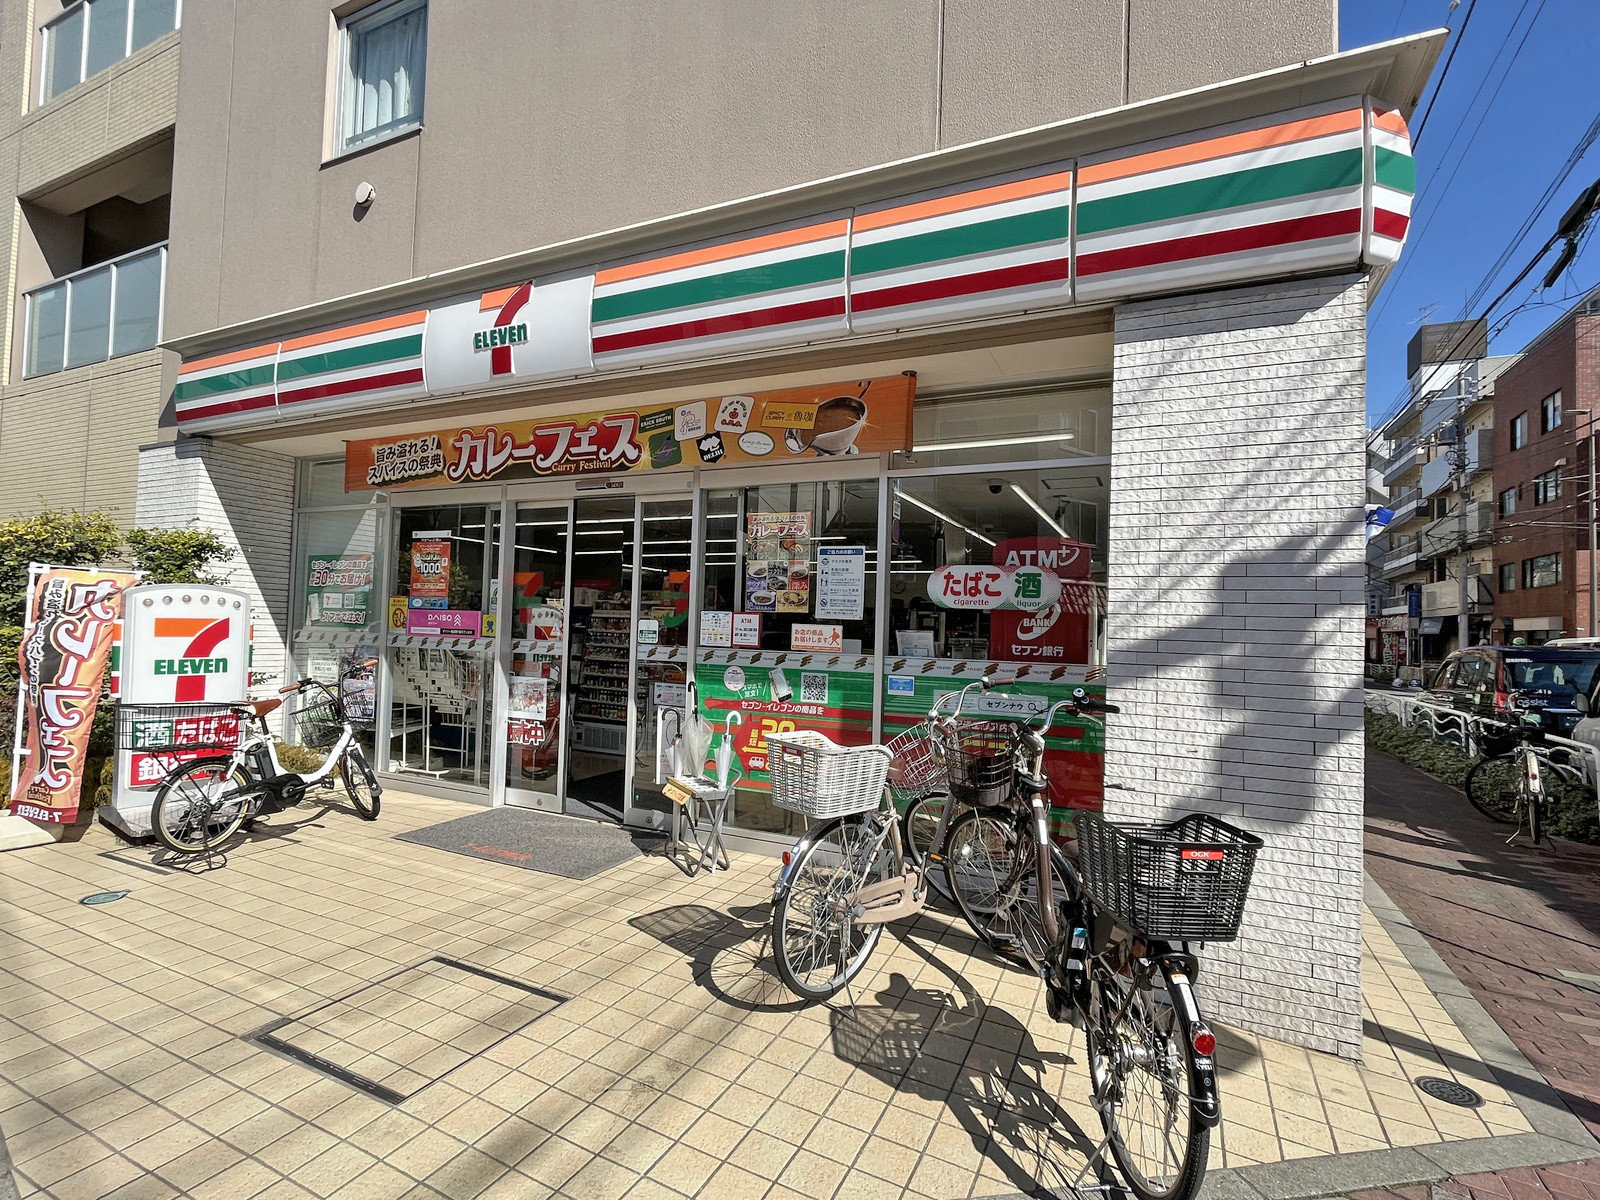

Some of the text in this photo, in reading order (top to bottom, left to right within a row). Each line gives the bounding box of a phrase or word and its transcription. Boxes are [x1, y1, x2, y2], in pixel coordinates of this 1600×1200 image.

[655, 415, 672, 423] SOUTH
[449, 414, 641, 480] カレーフェス
[368, 454, 443, 481] スパイスの祭典
[551, 459, 612, 474] Curry Festival
[749, 523, 809, 538] カレーフェス
[943, 571, 1042, 599] たばこ 酒
[1016, 600, 1042, 608] liquor
[427, 613, 452, 622] DAISO
[1023, 617, 1052, 627] BANK
[1011, 644, 1064, 657] セブン銀行
[154, 618, 230, 703] 7
[986, 701, 1024, 710] セブンナウ
